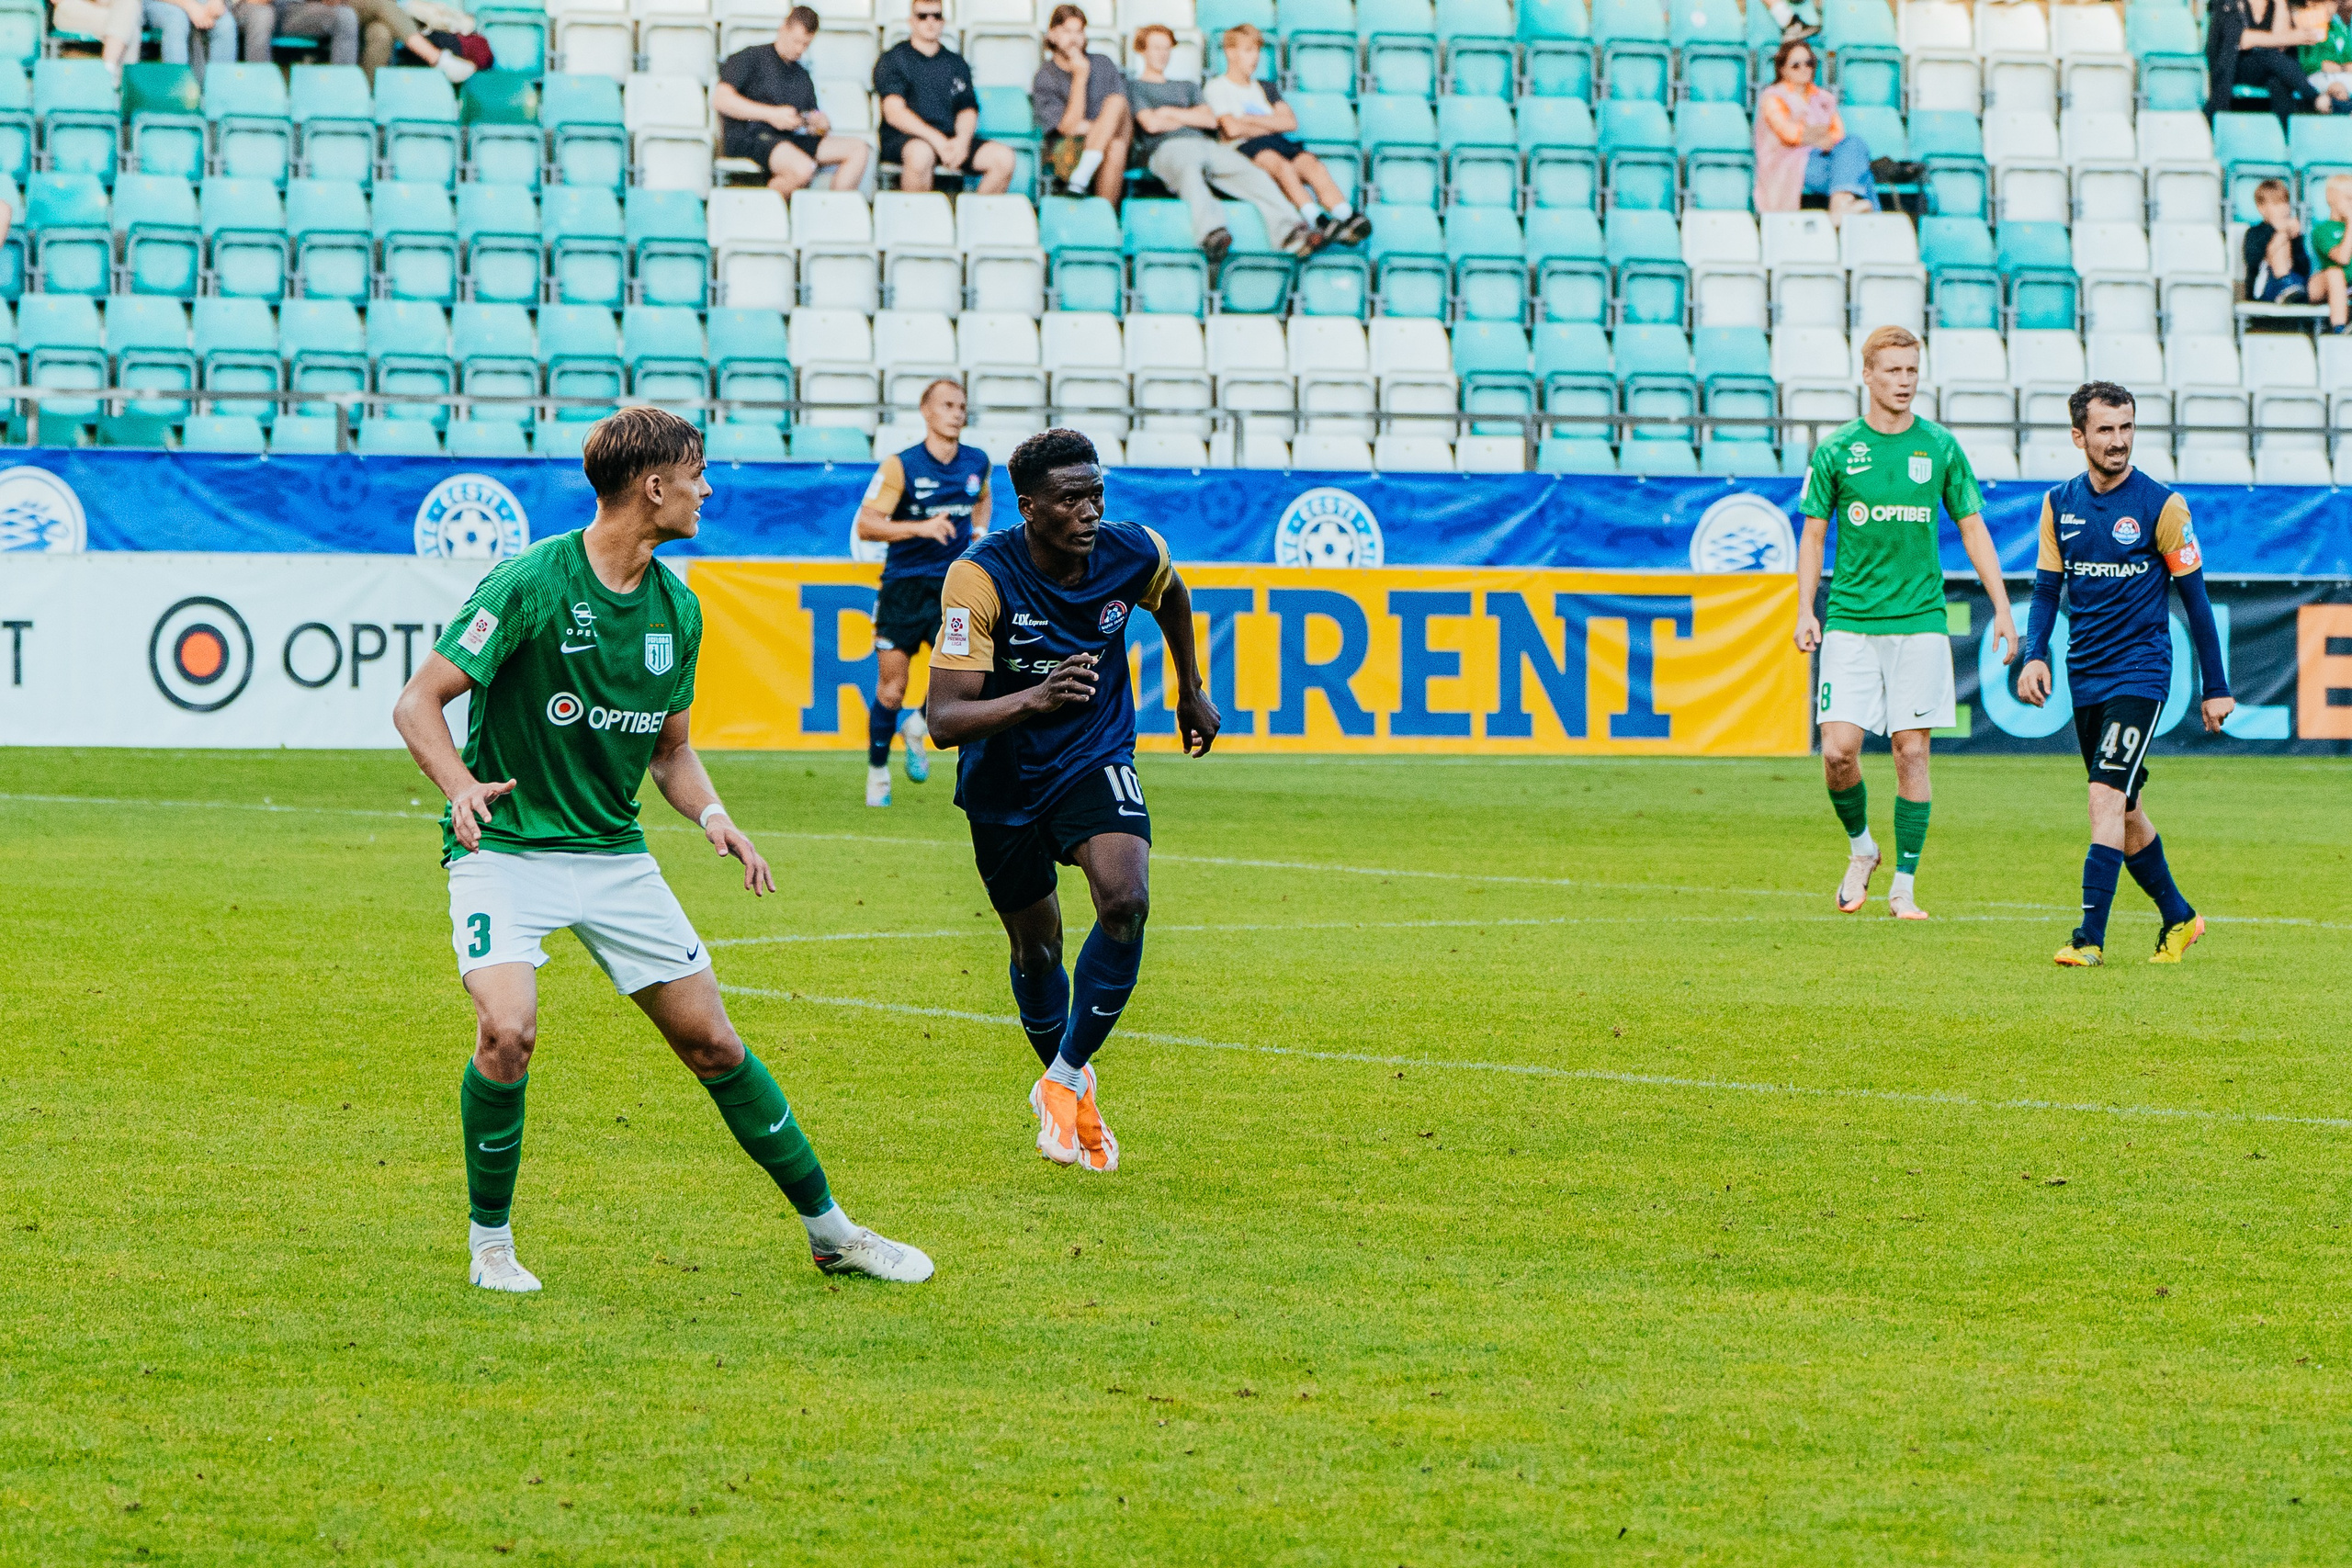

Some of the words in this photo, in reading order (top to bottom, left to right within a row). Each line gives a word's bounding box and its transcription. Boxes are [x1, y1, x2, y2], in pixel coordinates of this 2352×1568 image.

[1871, 506, 1931, 524] OPTIBET
[2074, 561, 2149, 578] SPORTLAND
[566, 628, 598, 637] OPEL
[800, 584, 1694, 740] RIRENT
[1821, 682, 1831, 712] 8
[2100, 722, 2141, 763] 49
[1104, 765, 1144, 806] 10
[467, 912, 491, 958] 3
